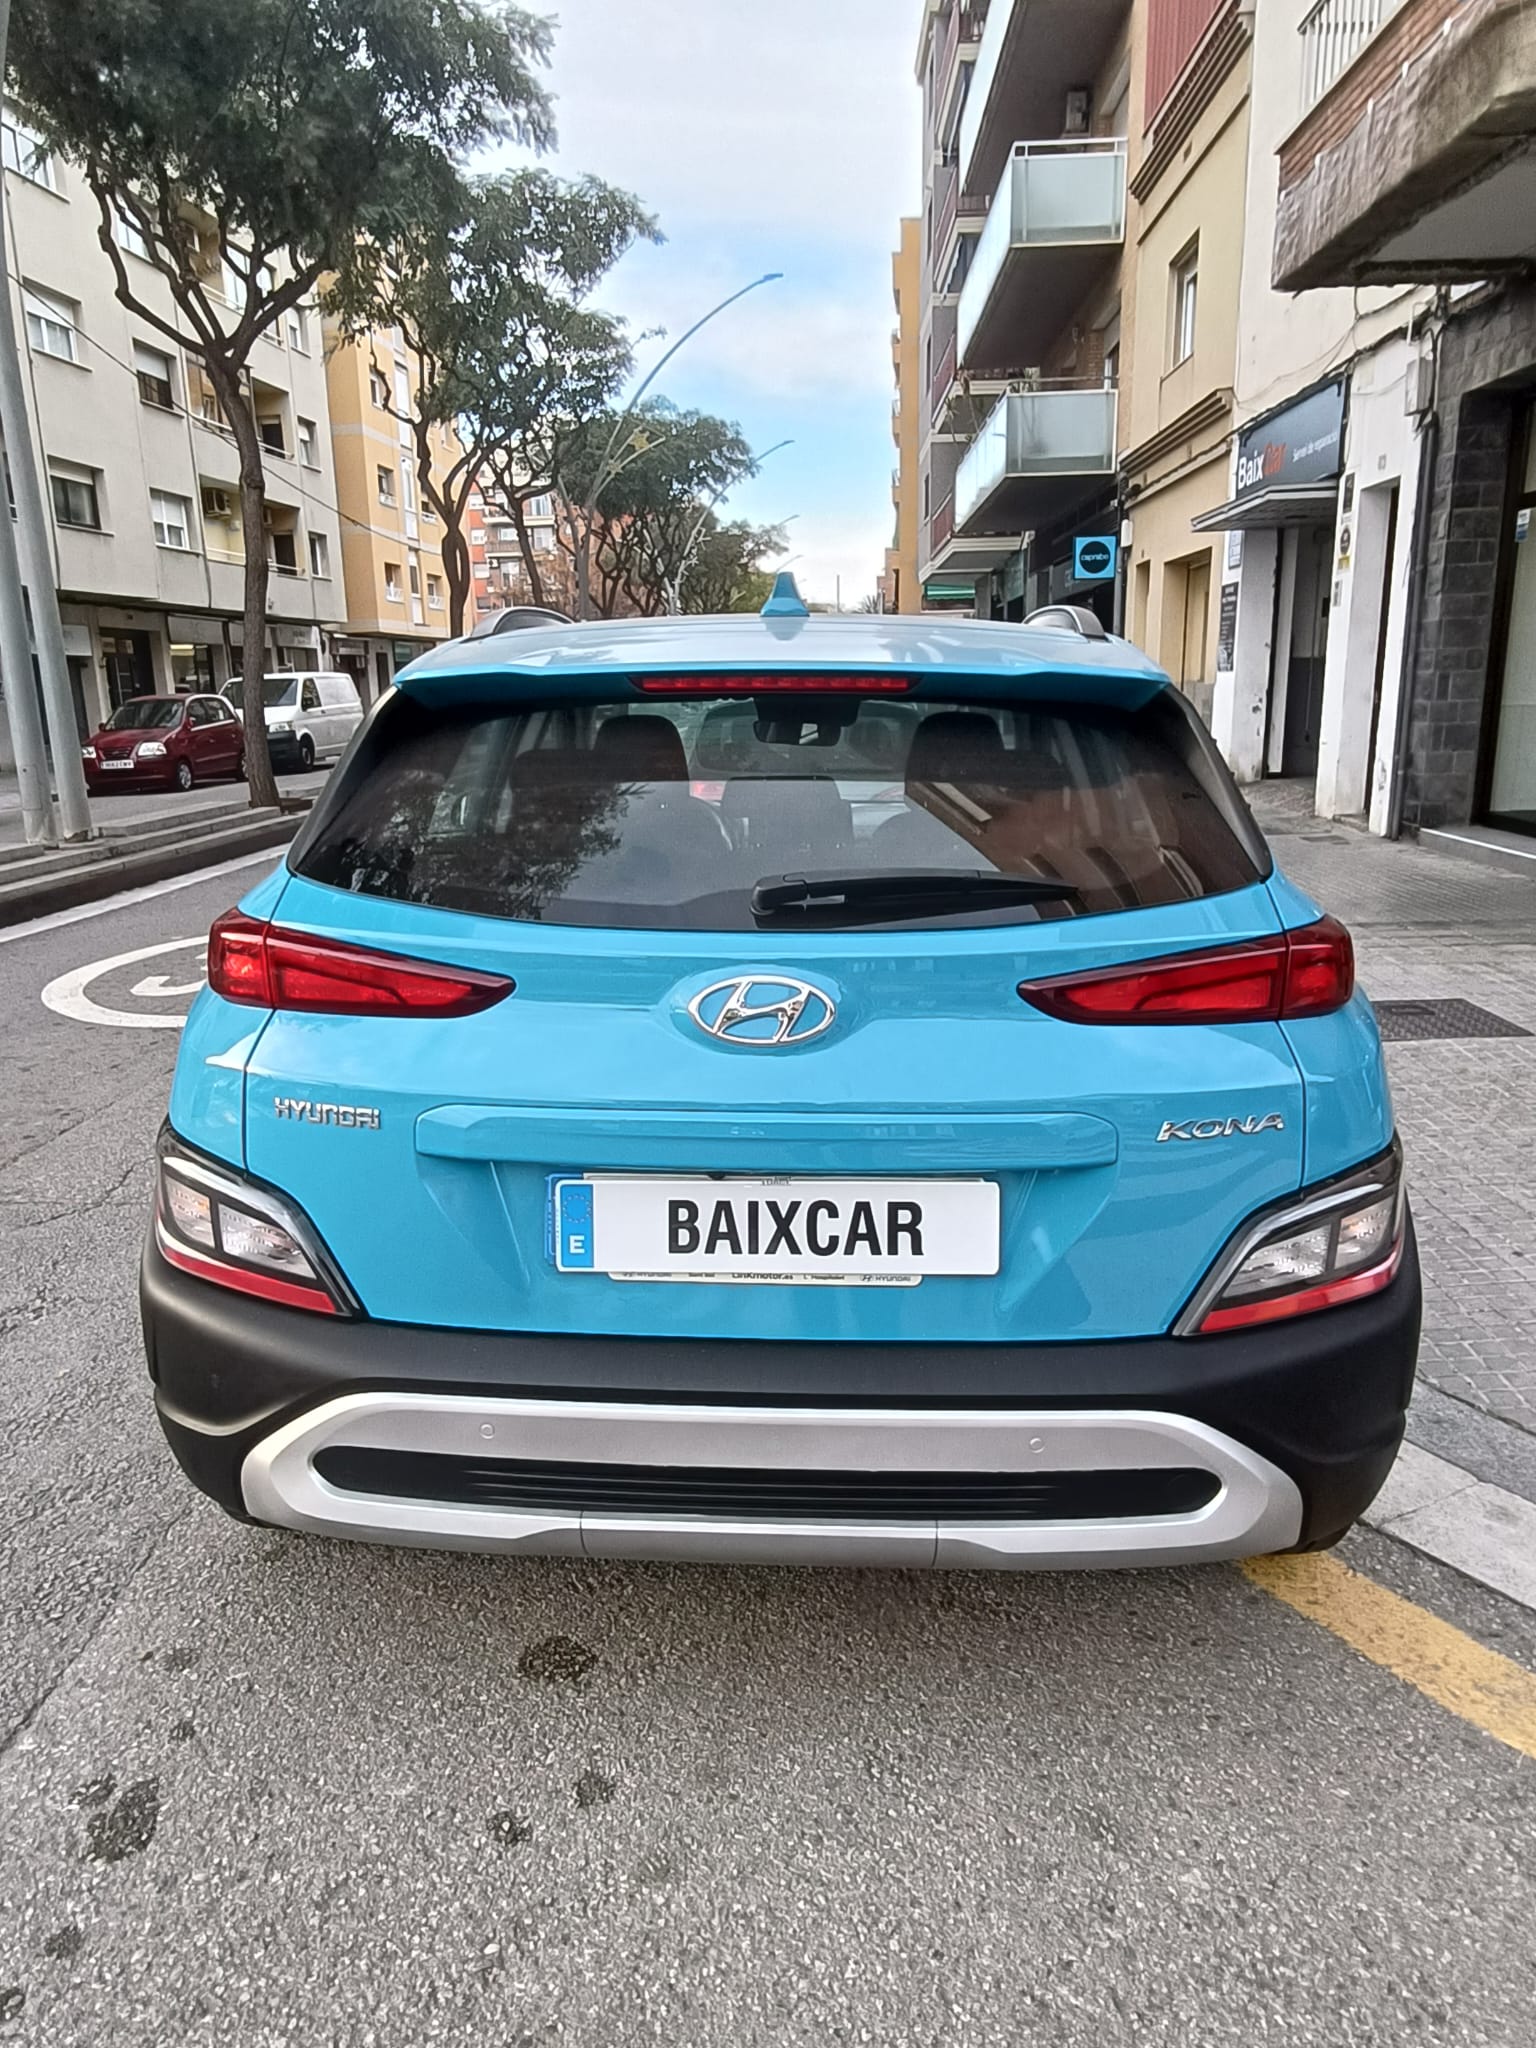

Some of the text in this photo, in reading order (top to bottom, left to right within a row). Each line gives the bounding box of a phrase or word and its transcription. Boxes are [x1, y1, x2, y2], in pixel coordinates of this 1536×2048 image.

[274, 1097, 381, 1129] HYUNDAI
[1157, 1112, 1284, 1141] KONA
[668, 1199, 924, 1257] BAIXCAR
[569, 1235, 585, 1254] E
